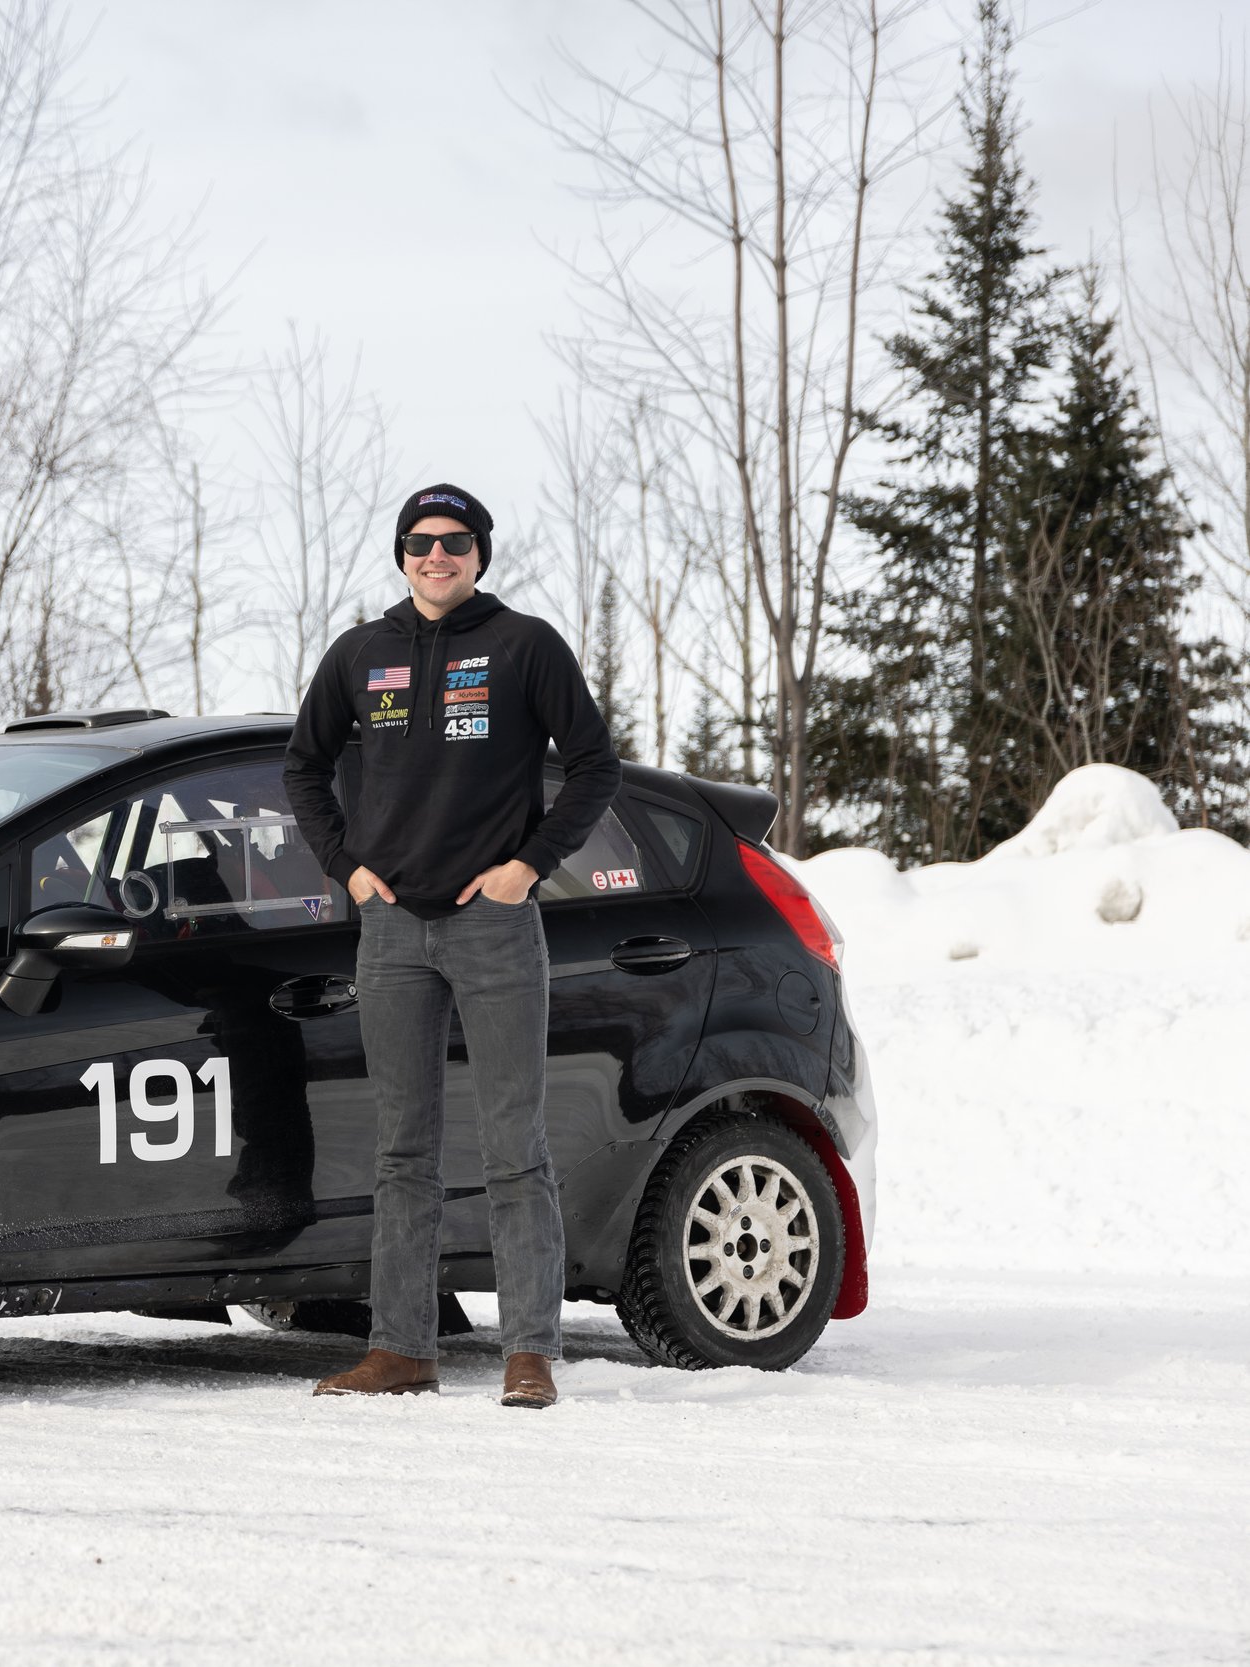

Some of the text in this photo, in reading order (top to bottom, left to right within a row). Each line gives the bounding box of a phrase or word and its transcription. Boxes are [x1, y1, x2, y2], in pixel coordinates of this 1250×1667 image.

[460, 656, 489, 669] RRS
[446, 671, 488, 688] TRF
[386, 709, 408, 719] RACING
[595, 874, 605, 886] E
[79, 1057, 232, 1164] 191
